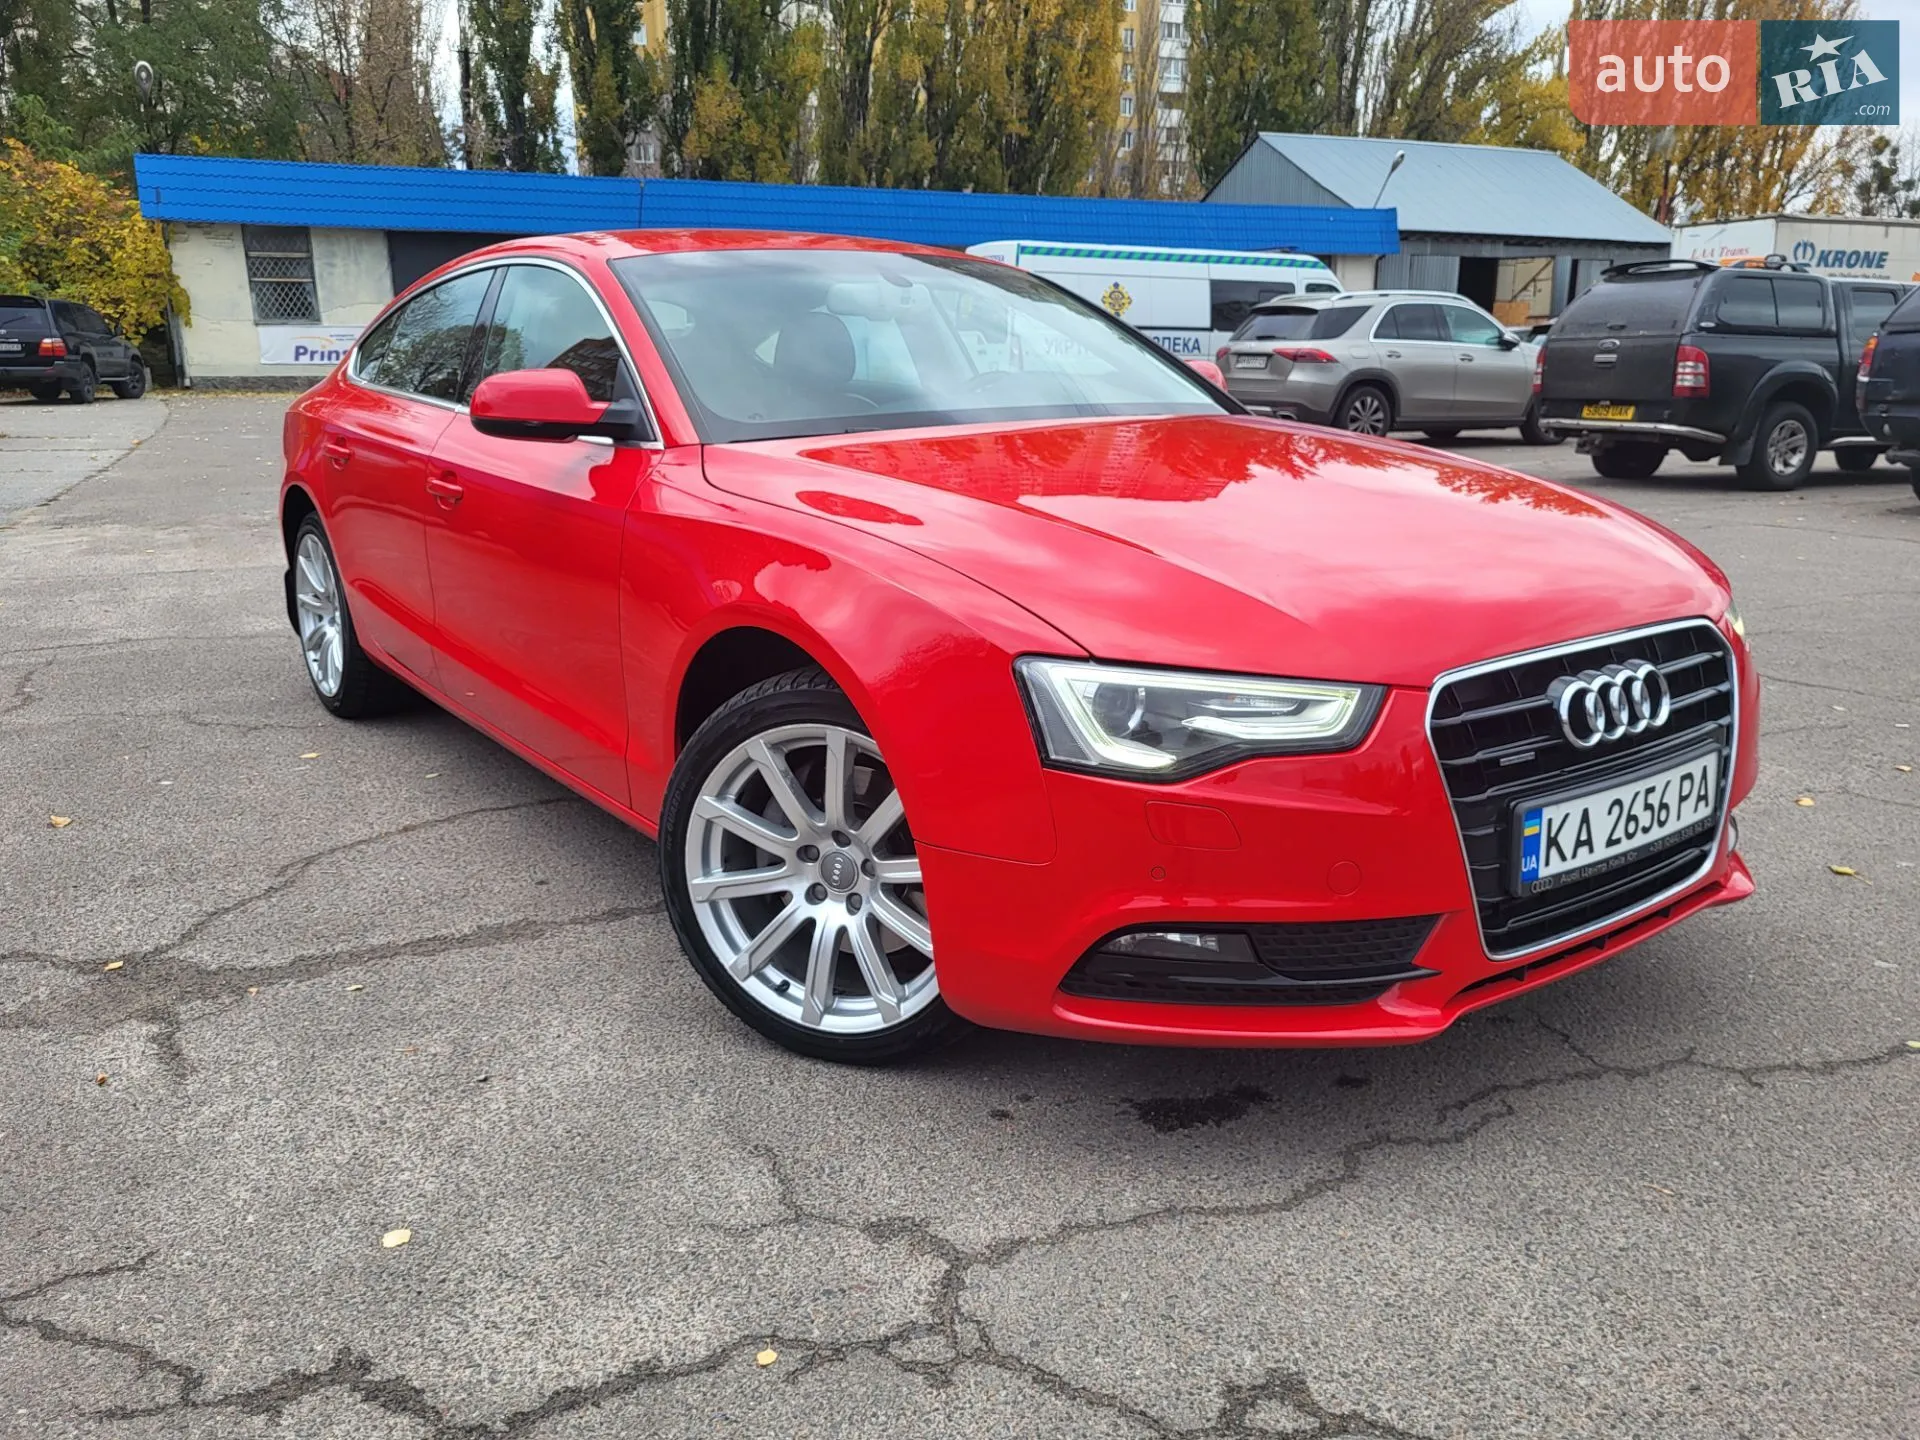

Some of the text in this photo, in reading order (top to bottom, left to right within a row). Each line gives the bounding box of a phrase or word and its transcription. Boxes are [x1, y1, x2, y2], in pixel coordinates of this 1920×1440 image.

[1816, 249, 1889, 269] KRONE
[1545, 807, 1595, 868] KA
[1605, 780, 1672, 848] 2656
[1676, 765, 1710, 822] PA
[1521, 854, 1538, 872] UA
